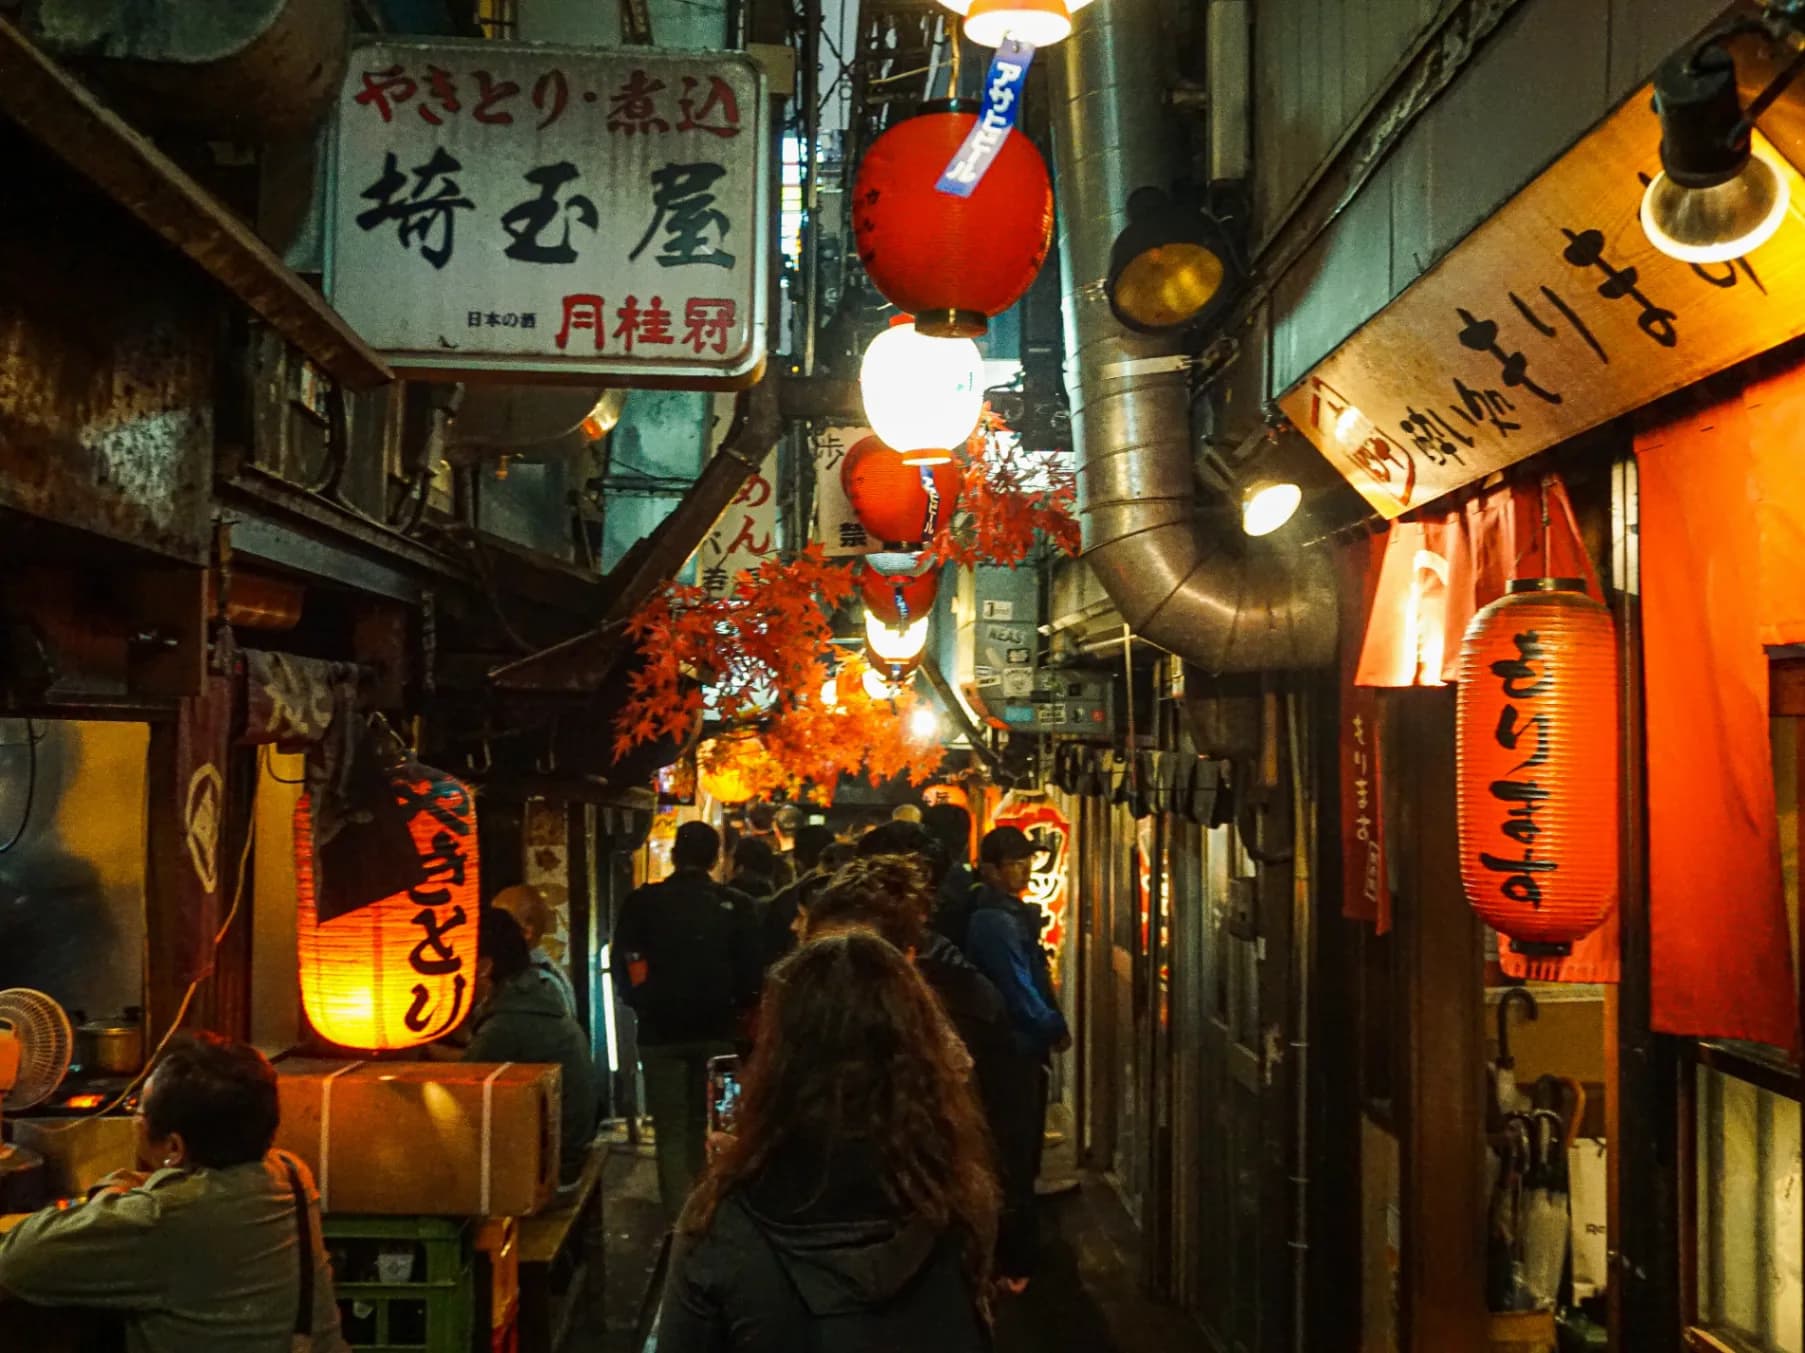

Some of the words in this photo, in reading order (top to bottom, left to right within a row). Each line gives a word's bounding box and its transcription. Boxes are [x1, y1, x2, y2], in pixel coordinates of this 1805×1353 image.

[948, 61, 1022, 184] アサヒビール
[355, 145, 737, 270] 埼玉屋
[466, 310, 537, 329] 日本の酒
[555, 293, 737, 354] 月桂冠
[397, 772, 473, 1041] やきとり
